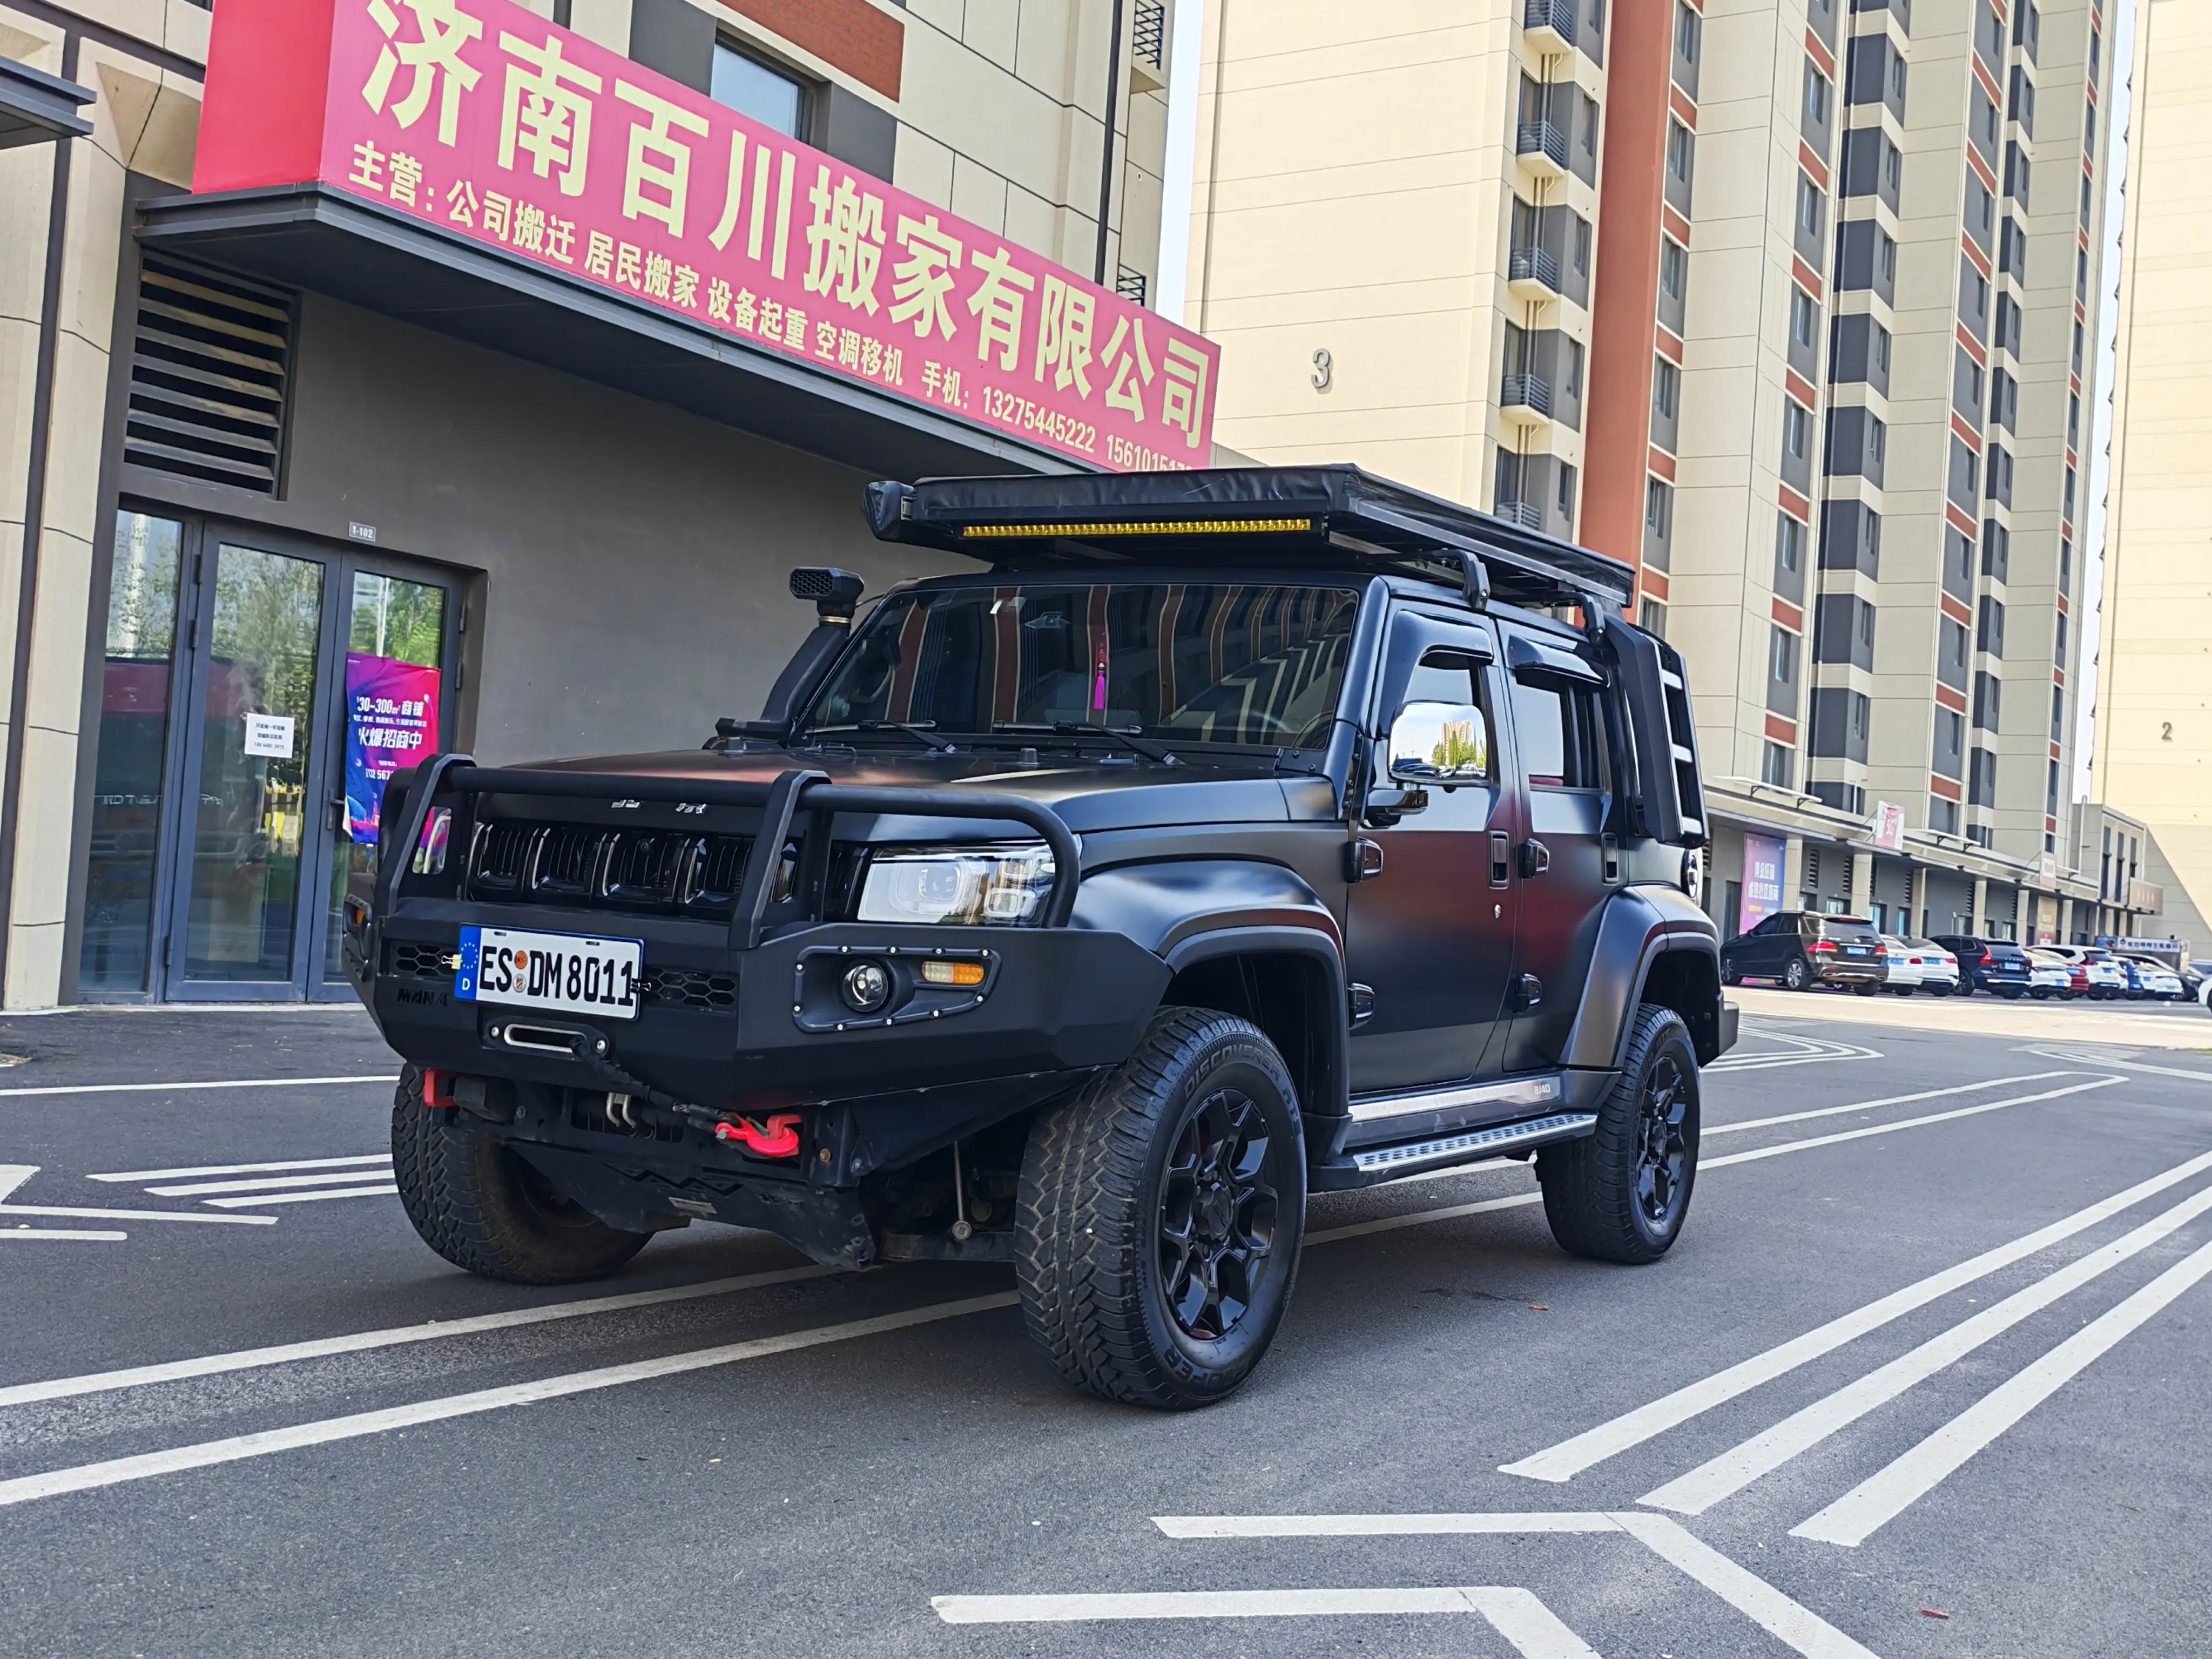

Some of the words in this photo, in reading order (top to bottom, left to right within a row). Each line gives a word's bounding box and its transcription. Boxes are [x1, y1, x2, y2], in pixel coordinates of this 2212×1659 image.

[362, 0, 1208, 448] 济南百川搬家有限公司
[584, 230, 699, 308] 居民搬家
[707, 277, 807, 350] 设备起重
[815, 321, 902, 386] 空调移机
[1311, 347, 1330, 388] 3
[353, 525, 373, 538] 1-102
[359, 726, 422, 750] 火爆招商中
[2161, 721, 2172, 740] 2
[462, 978, 470, 990] D
[479, 946, 513, 993] ES
